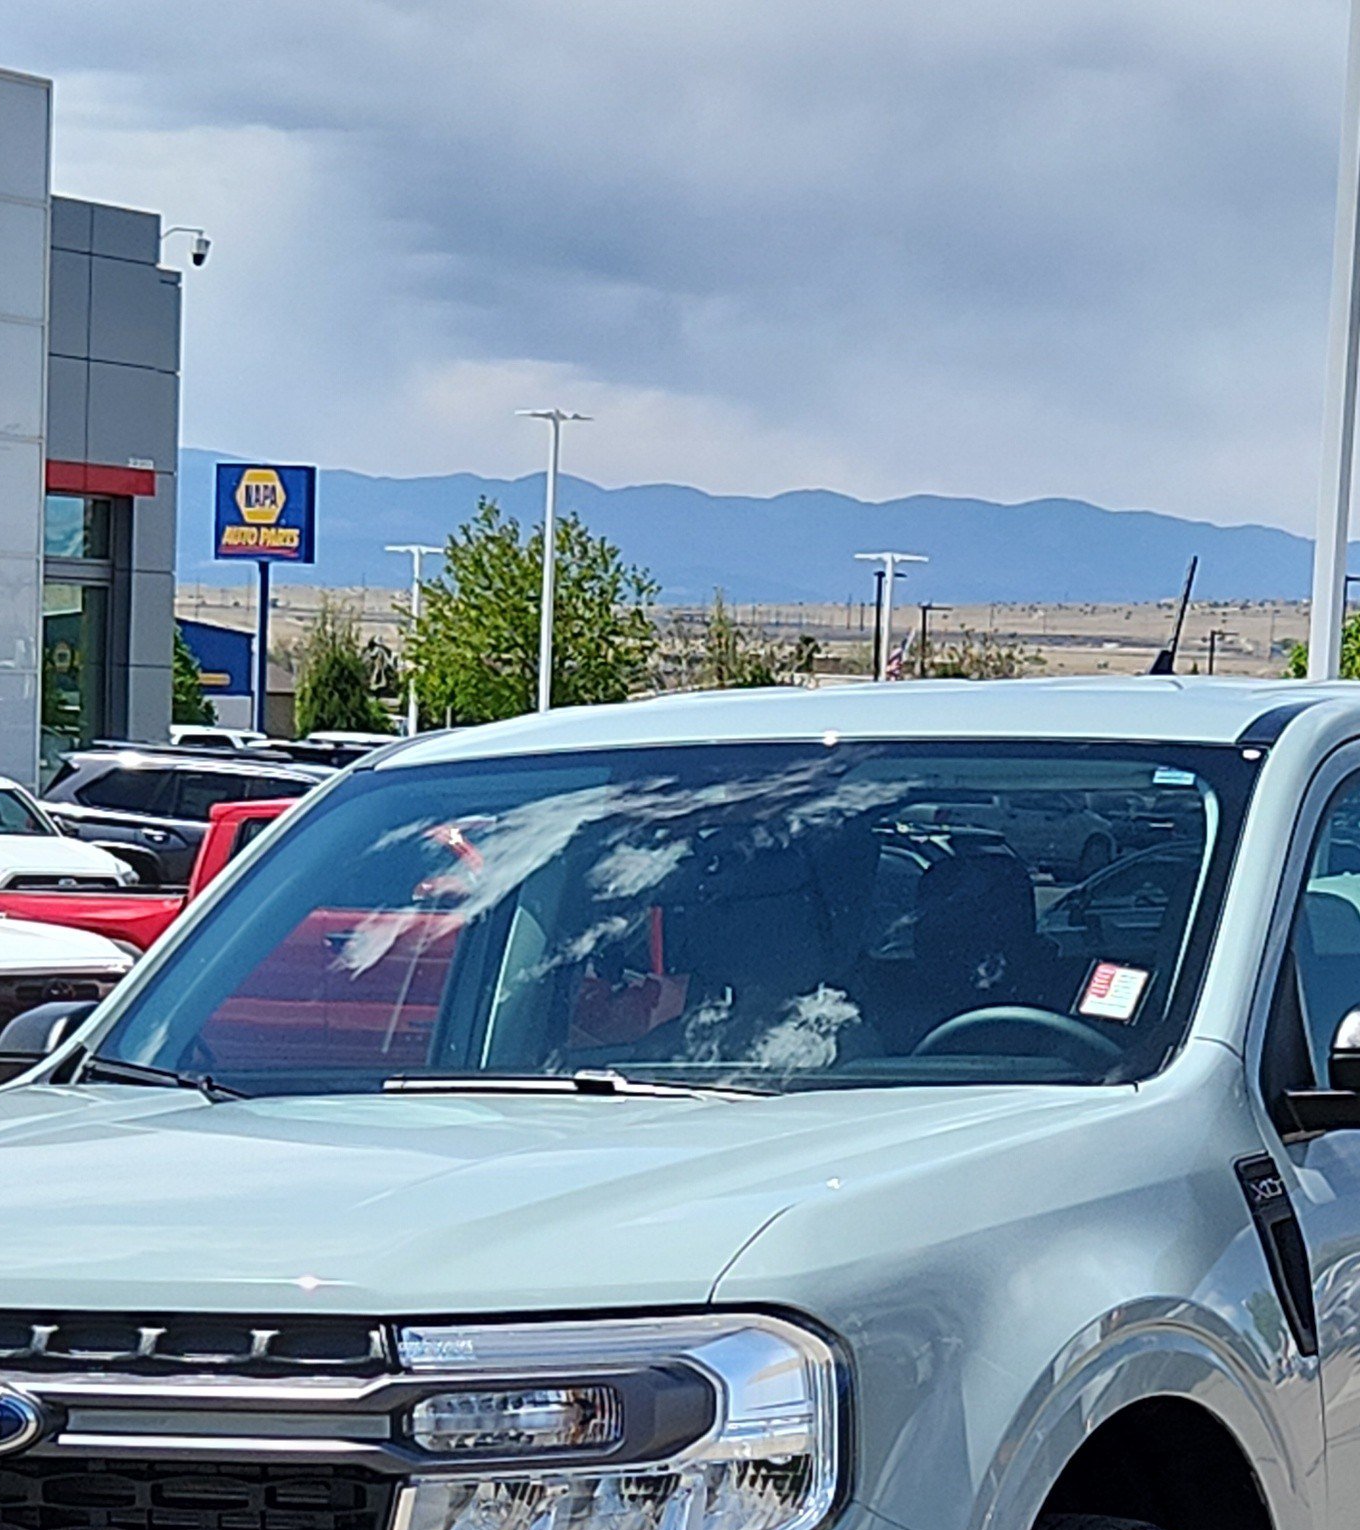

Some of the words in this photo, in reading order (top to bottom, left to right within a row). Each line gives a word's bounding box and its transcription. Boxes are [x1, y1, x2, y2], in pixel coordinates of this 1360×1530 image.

[244, 484, 278, 508] NAPA
[222, 525, 258, 546] AUTO
[259, 527, 300, 548] PARTS
